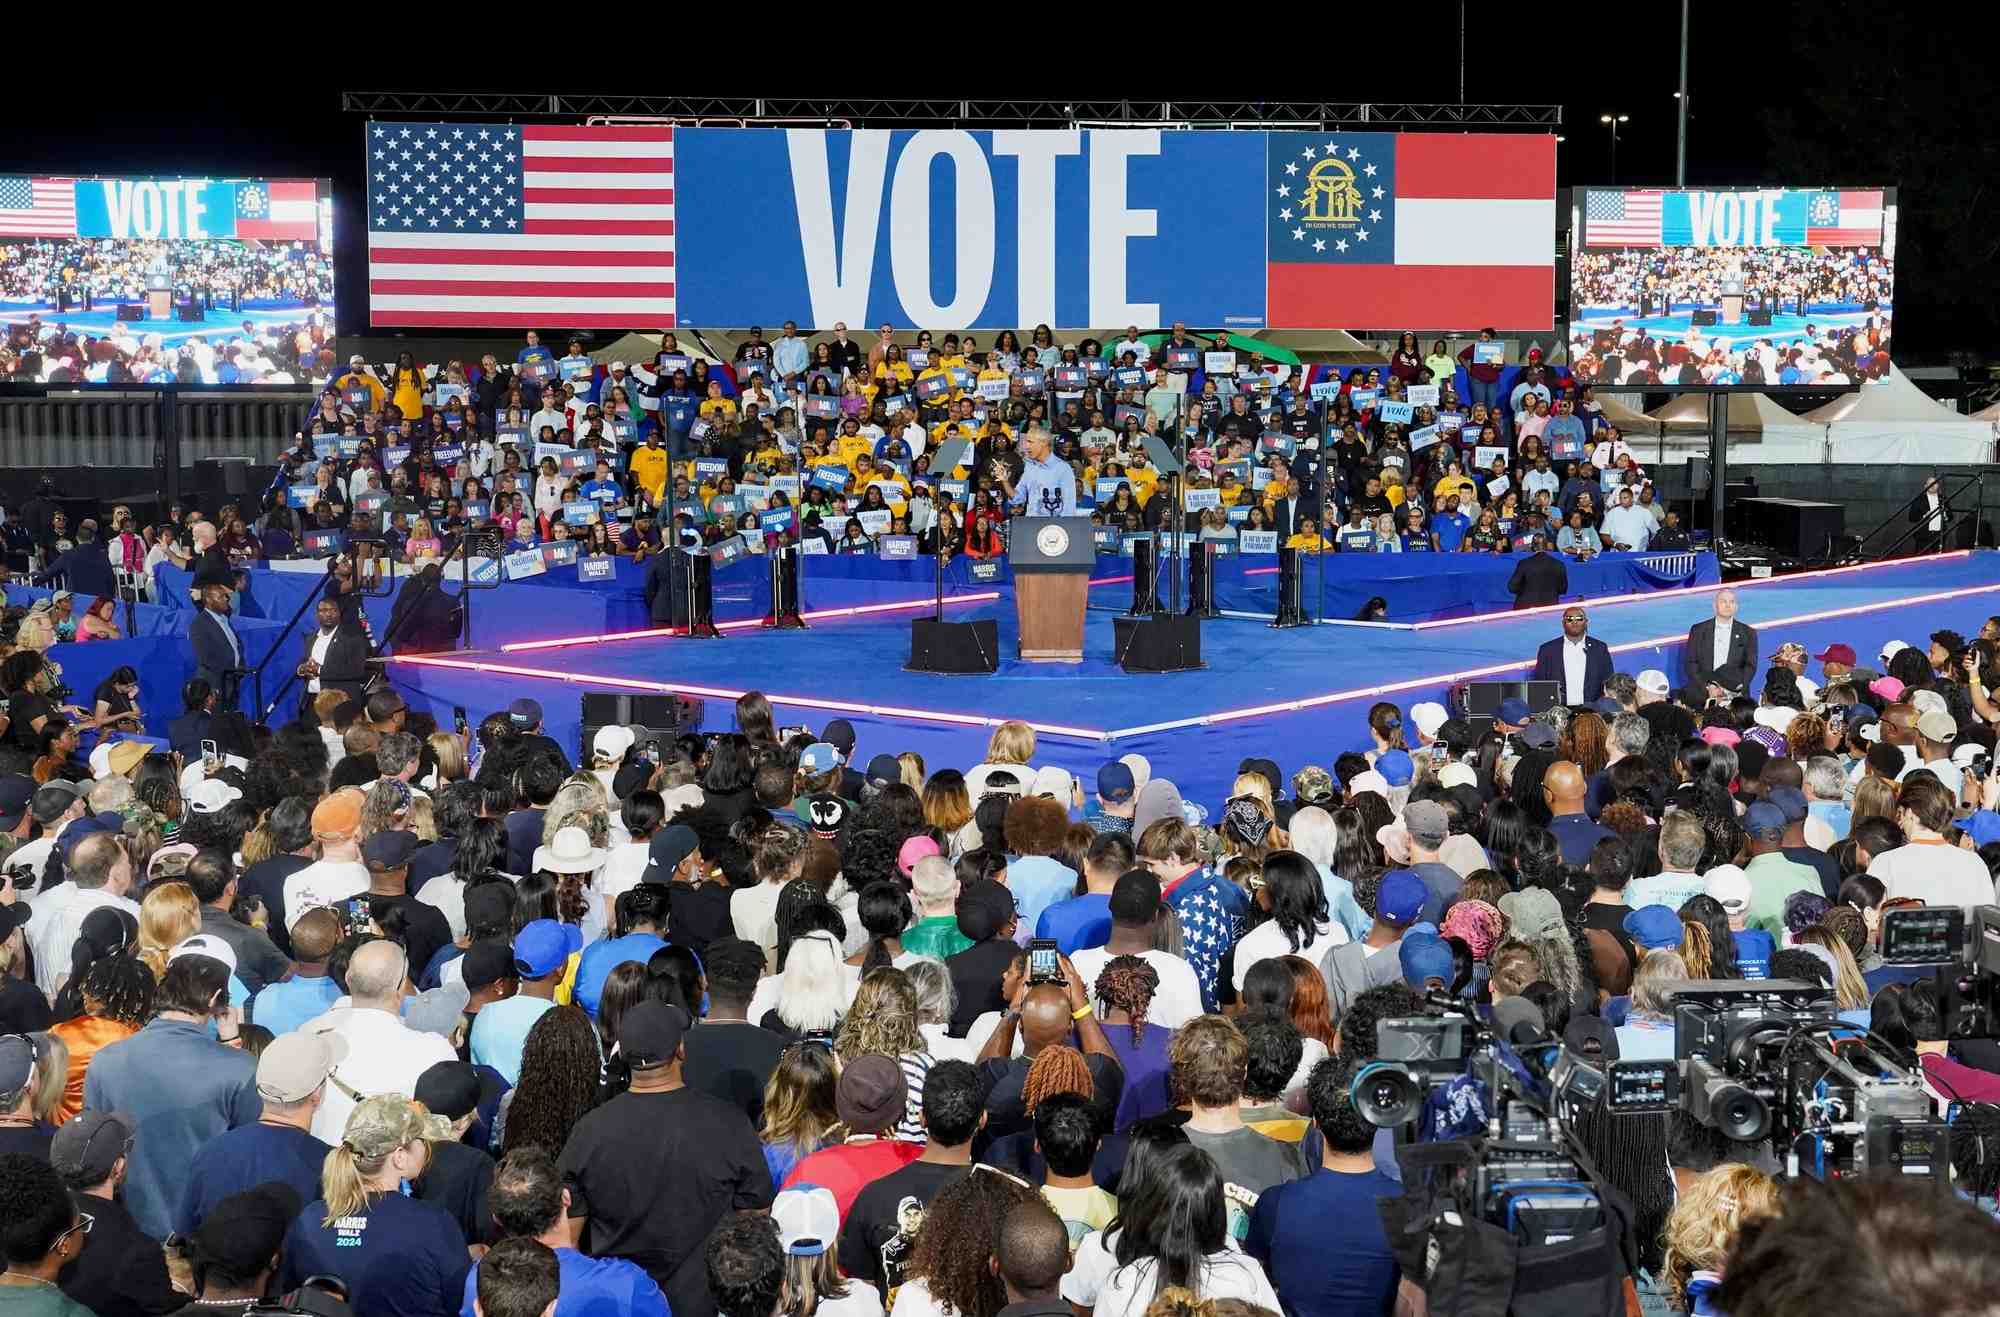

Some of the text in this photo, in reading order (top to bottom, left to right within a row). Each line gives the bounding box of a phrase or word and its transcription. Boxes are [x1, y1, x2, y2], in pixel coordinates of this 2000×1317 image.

[102, 180, 208, 240] VOTE
[1688, 190, 1783, 247] VOTE
[786, 127, 1161, 330] VOTE
[697, 462, 726, 473] FREEDOM
[816, 468, 846, 484] FREEDOM
[761, 511, 791, 526] FREEDOM
[584, 560, 609, 571] HARRIS
[588, 569, 606, 577] WALZ
[335, 1216, 368, 1230] HARRIS
[337, 1229, 361, 1237] WALZ
[336, 1237, 362, 1247] 2024
